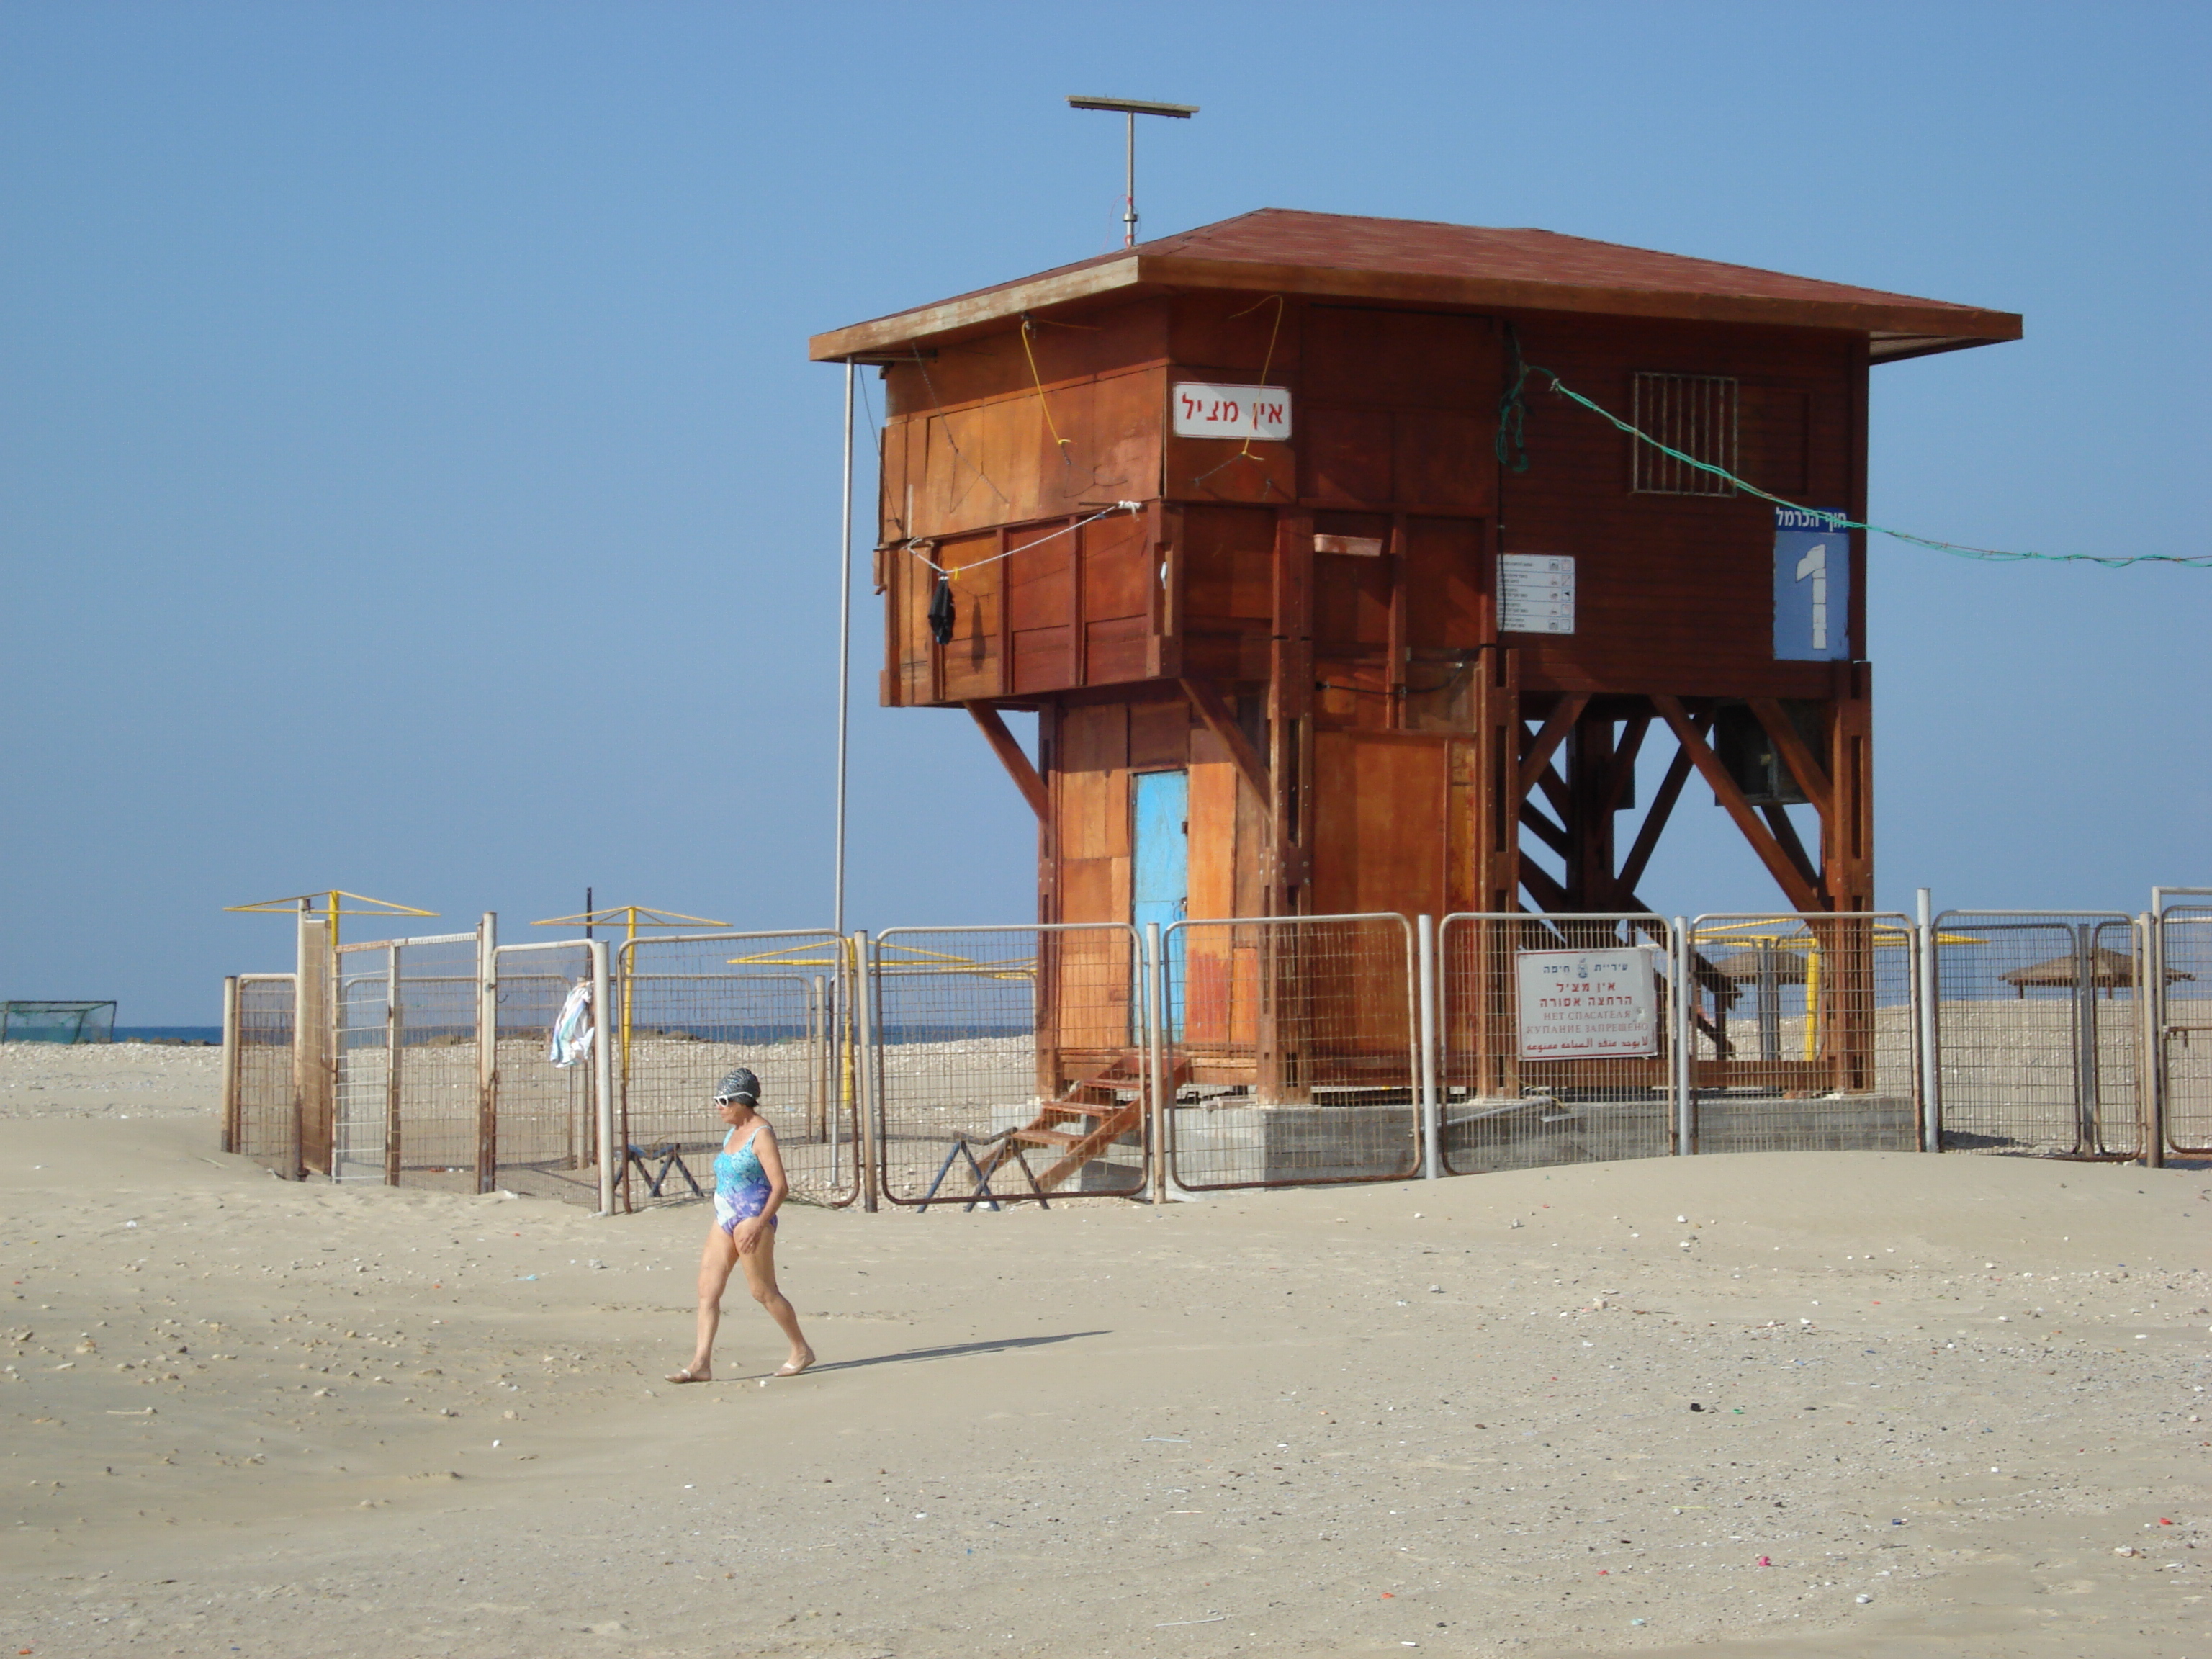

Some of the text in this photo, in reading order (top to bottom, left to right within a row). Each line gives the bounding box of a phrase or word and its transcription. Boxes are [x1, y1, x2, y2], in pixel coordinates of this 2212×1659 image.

[1251, 402, 1283, 430] אין
[1775, 506, 1820, 527] הכרמל
[1795, 543, 1827, 650] 1
[1542, 963, 1628, 974] עיריית חיפה
[1555, 982, 1616, 993] אין מציל
[1539, 996, 1632, 1008] הרחצה אסורה
[1543, 1010, 1632, 1021] НЕТ СПАСАТЕЛЯ
[1526, 1025, 1581, 1035] КУПАНИЕ
